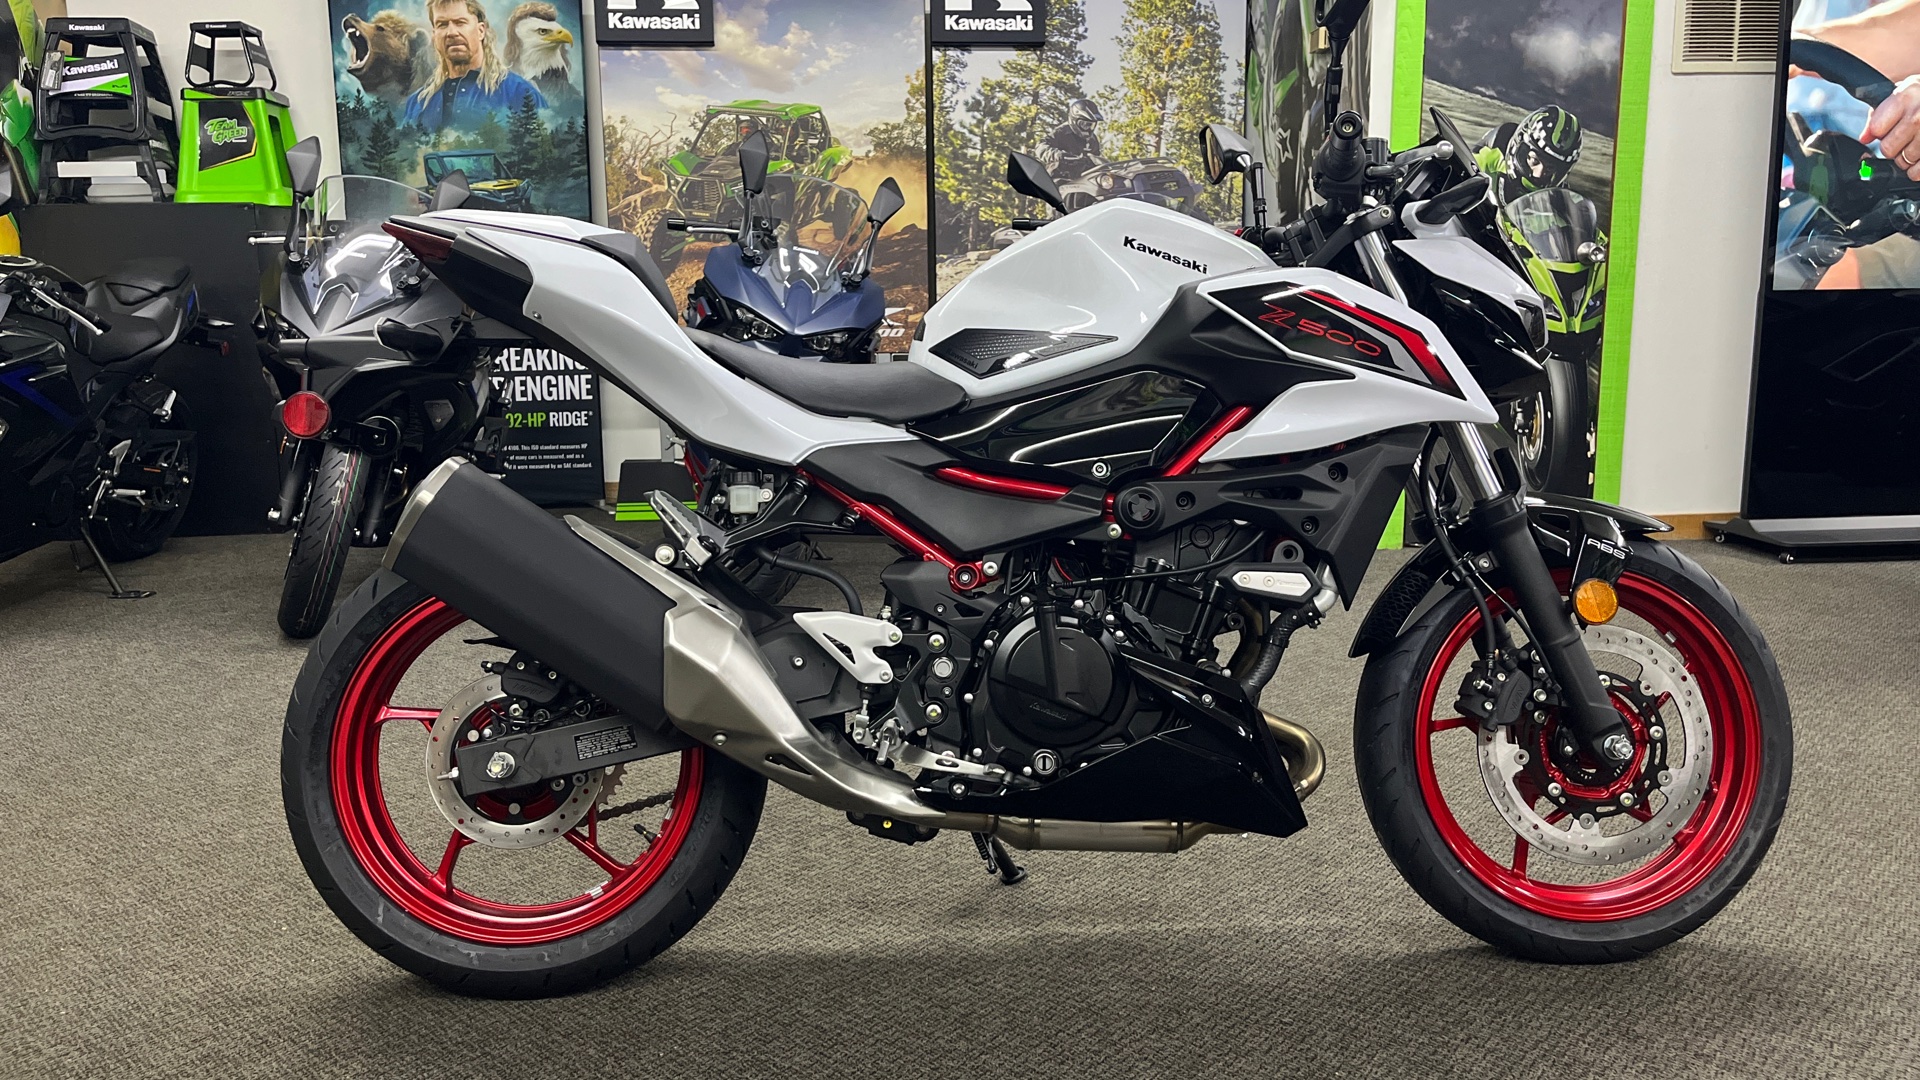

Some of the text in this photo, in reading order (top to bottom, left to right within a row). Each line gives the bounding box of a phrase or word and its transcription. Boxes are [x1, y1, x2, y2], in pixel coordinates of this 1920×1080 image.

[607, 12, 700, 29] Kawasaki
[944, 14, 1033, 31] Kawasaki
[62, 58, 119, 76] Kawasaki
[203, 117, 238, 135] TEAM
[212, 126, 248, 146] GREEN
[1123, 235, 1207, 275] Kawasaki
[498, 347, 589, 371] REAKIN
[514, 374, 593, 402] ENGINE
[505, 412, 547, 428] 02-HP
[1587, 538, 1626, 560] ABS
